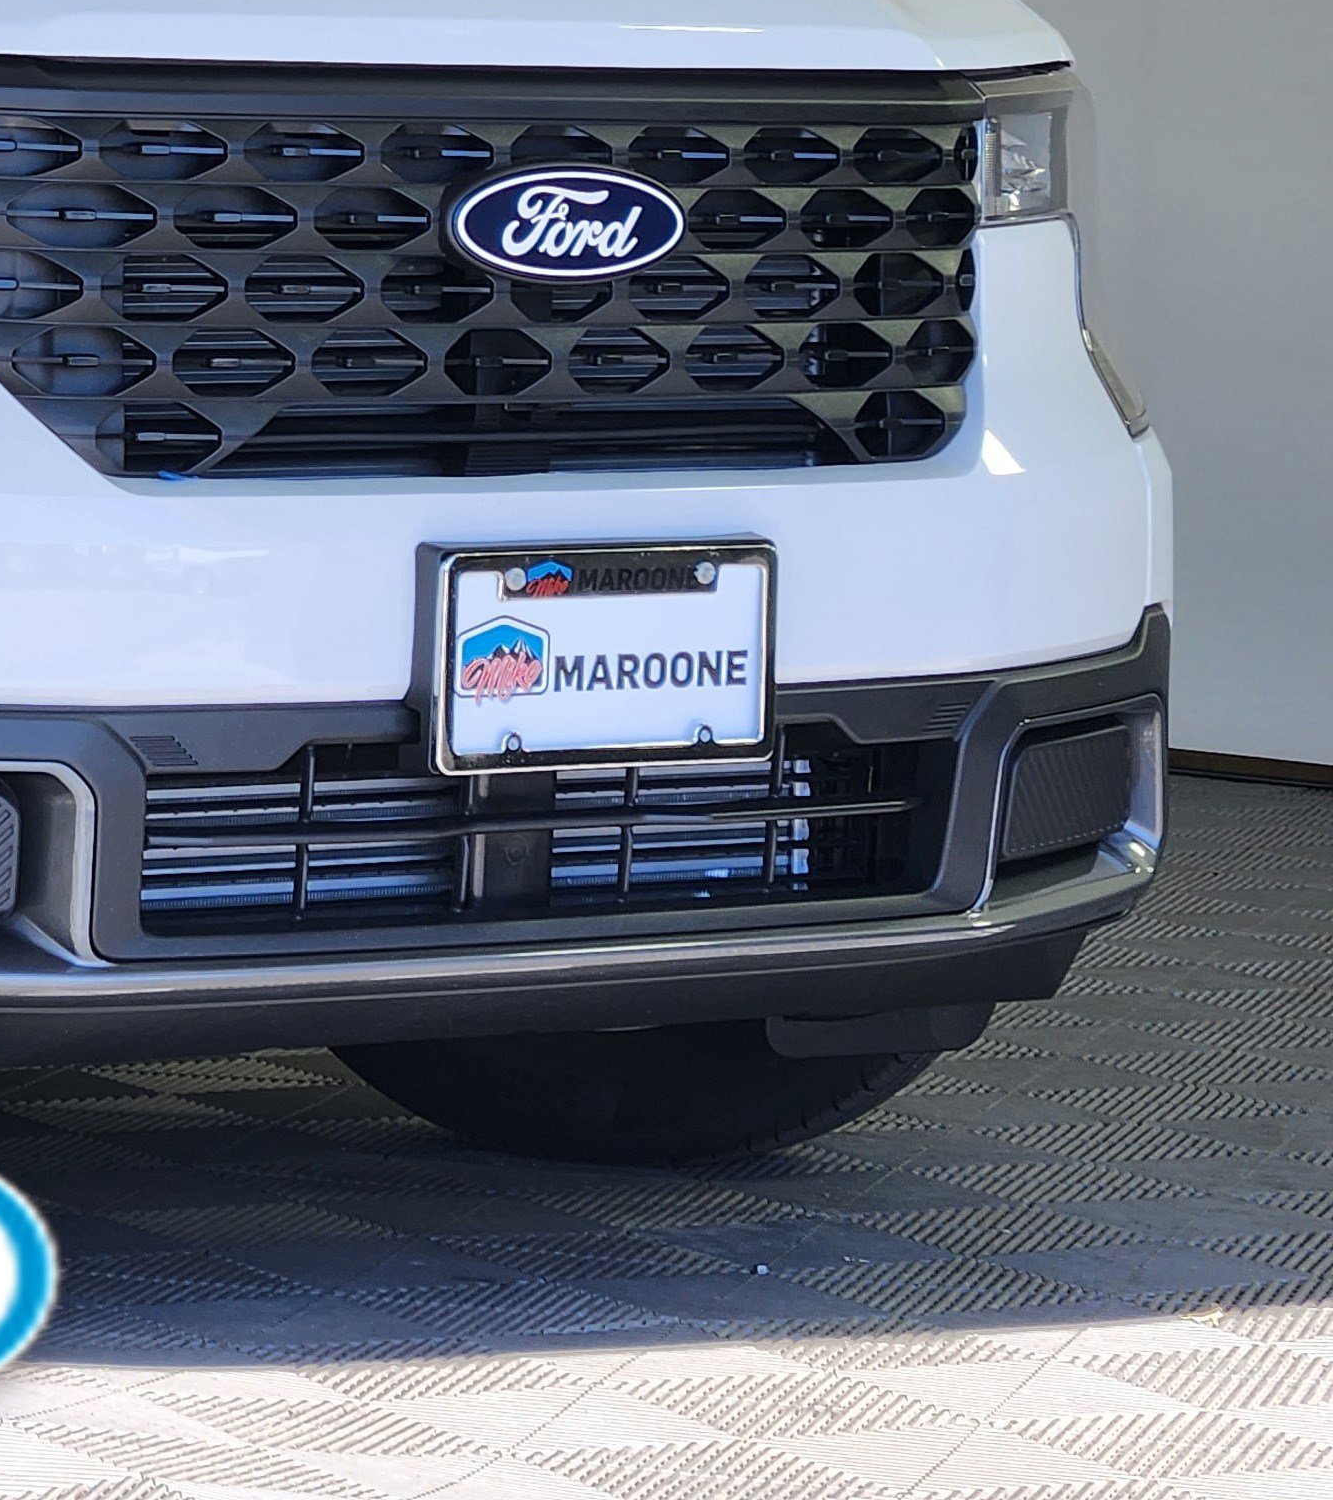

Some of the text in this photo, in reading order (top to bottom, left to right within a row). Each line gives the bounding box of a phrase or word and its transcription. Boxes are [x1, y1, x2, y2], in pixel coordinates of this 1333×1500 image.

[501, 185, 644, 258] Ford
[460, 648, 749, 704] Mike MAROONE
